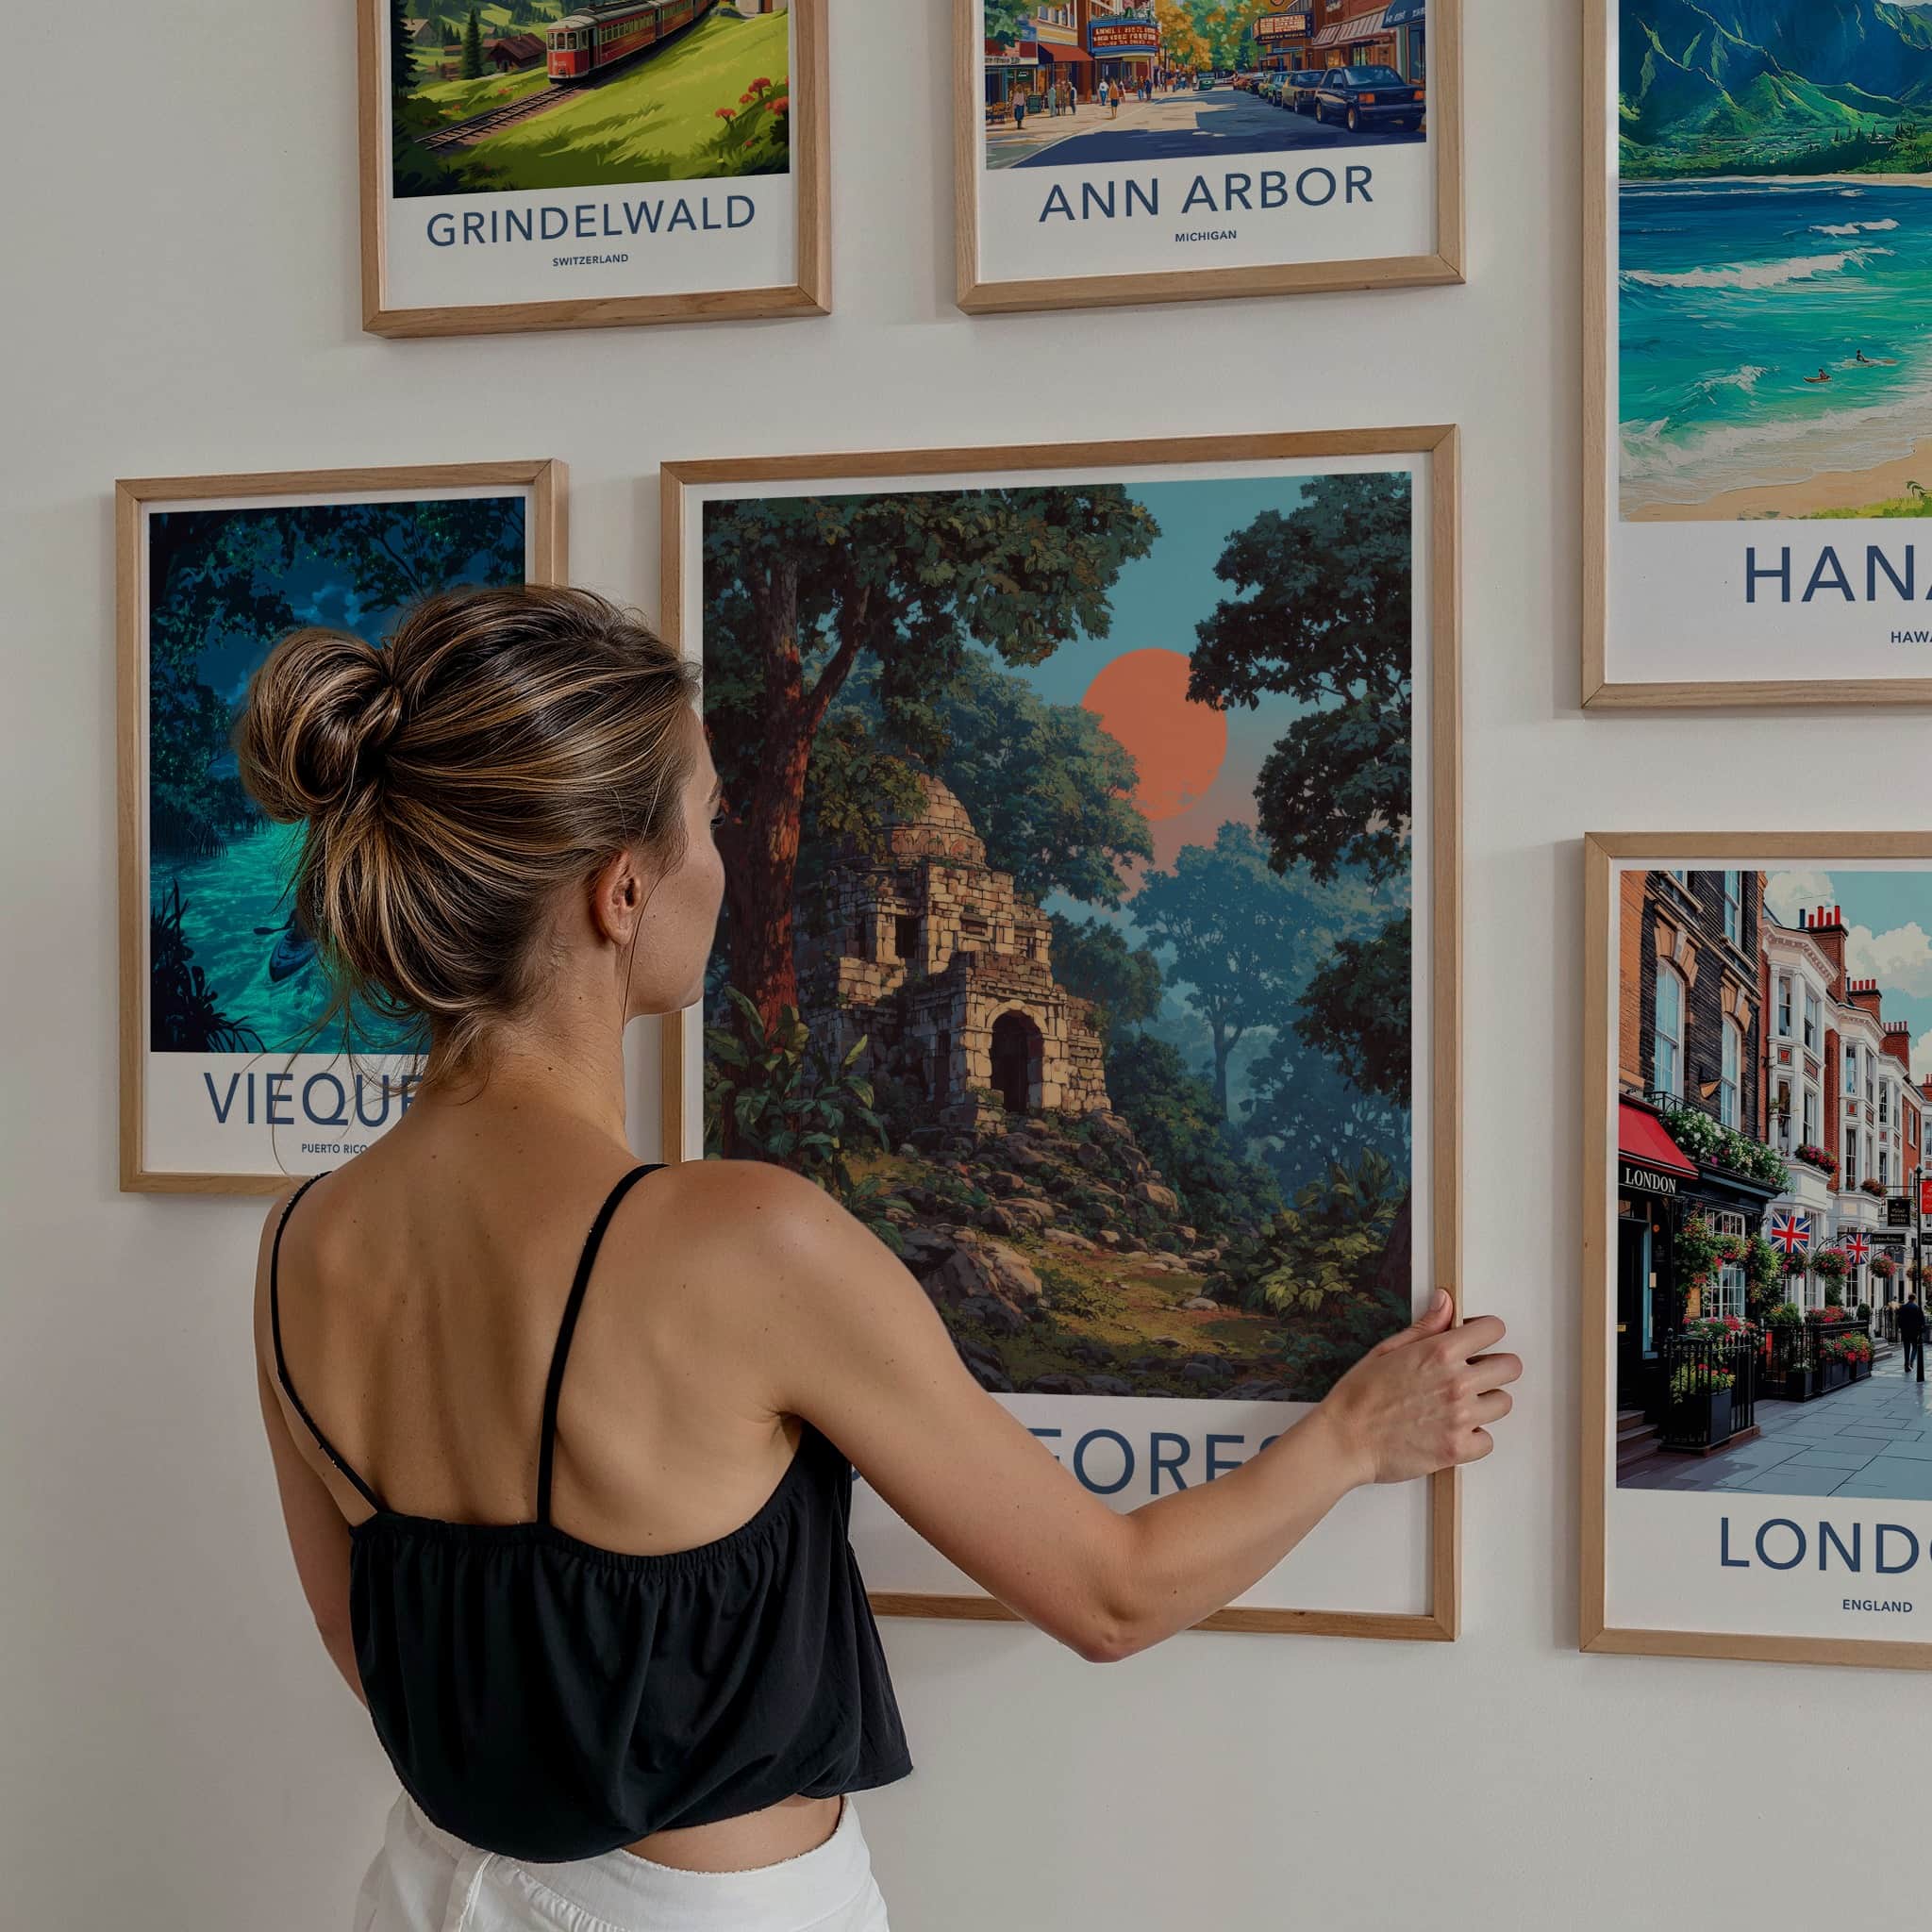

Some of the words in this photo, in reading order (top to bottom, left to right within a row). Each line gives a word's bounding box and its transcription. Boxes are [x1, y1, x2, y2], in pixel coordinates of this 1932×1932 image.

[1039, 177, 1159, 223] ANN
[1181, 165, 1374, 214] ARBOR
[427, 195, 756, 247] GRINDELWALD
[1174, 229, 1238, 242] MICHIGAN
[553, 254, 629, 267] SWITZERLAND
[1746, 545, 1932, 603] HAN
[1890, 630, 1932, 643] HAW
[301, 1143, 341, 1154] PUERTO
[1624, 1168, 1676, 1194] LONDON
[1026, 1427, 1281, 1495] ORE
[1721, 1516, 1932, 1574] LOND
[1842, 1599, 1913, 1613] ENGLAND
